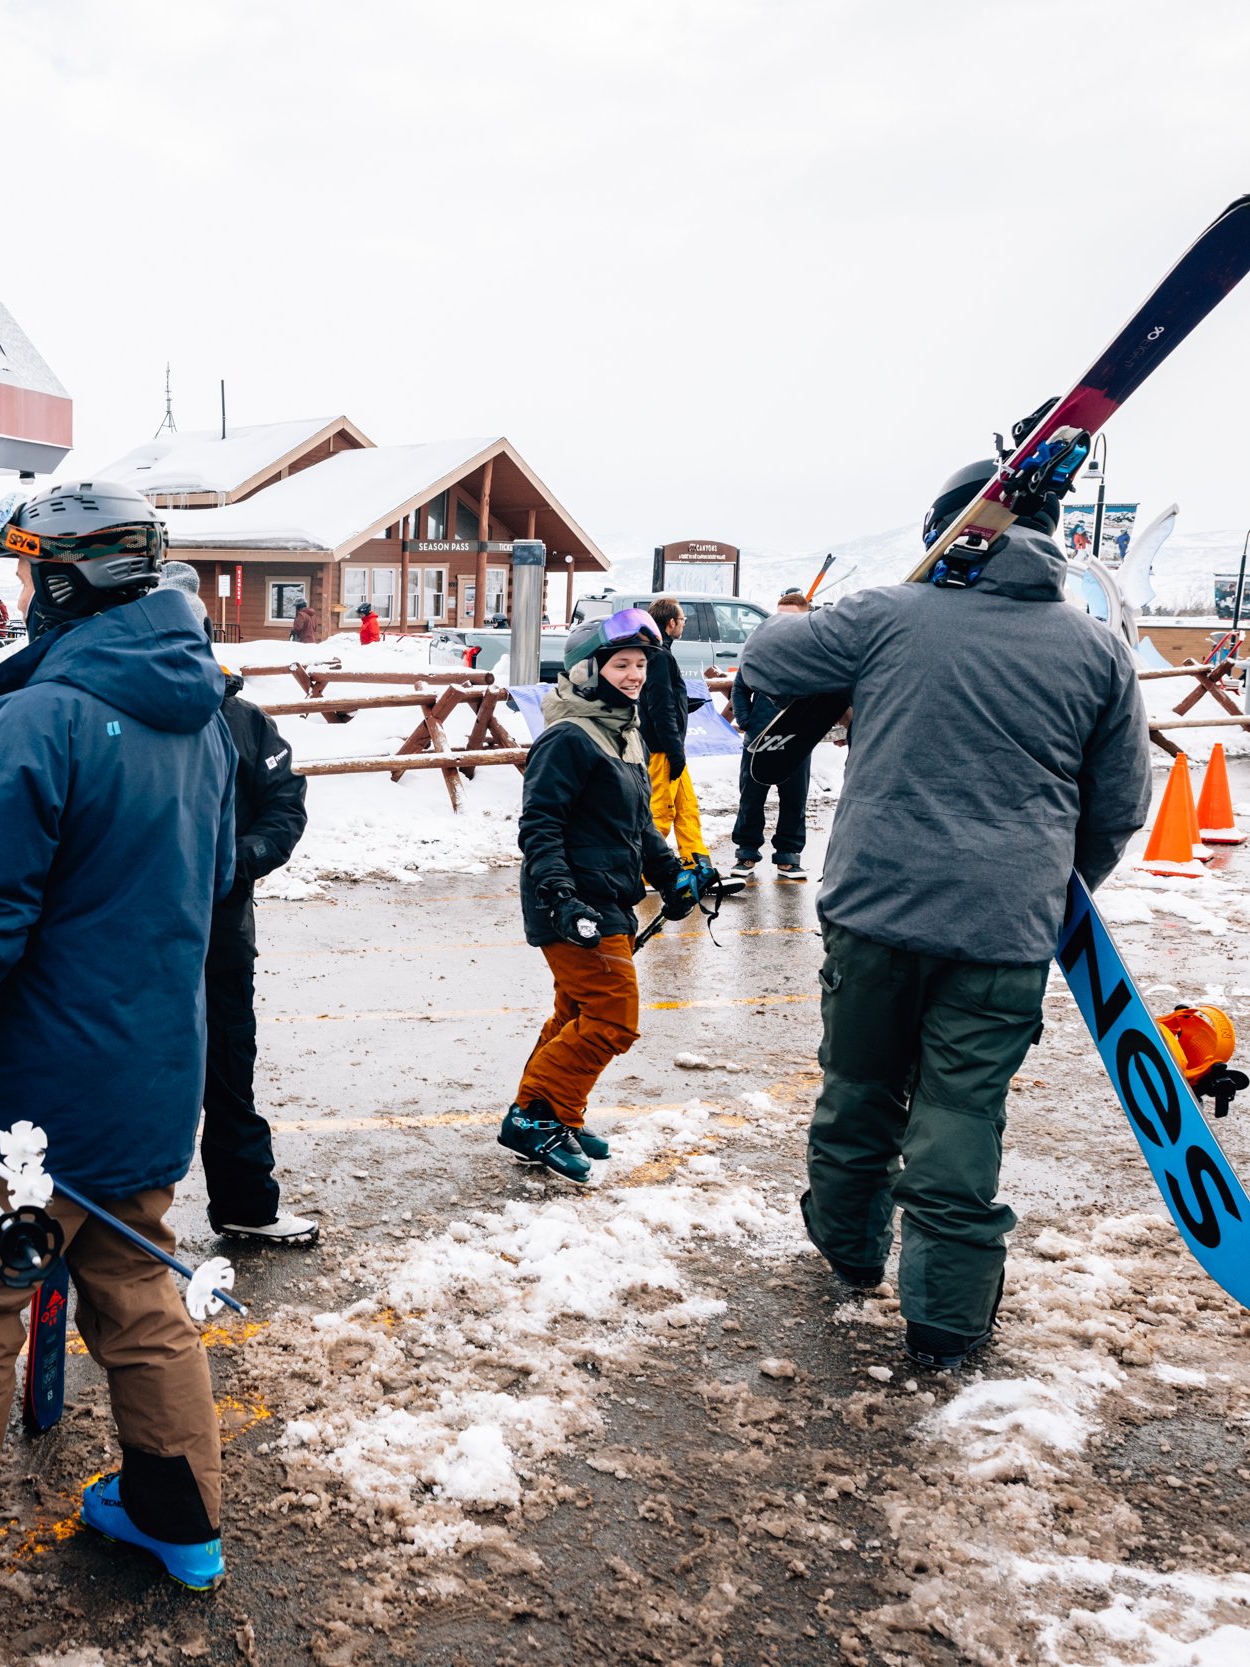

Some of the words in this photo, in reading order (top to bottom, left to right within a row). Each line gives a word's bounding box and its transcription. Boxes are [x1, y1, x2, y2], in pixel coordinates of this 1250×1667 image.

[8, 533, 27, 548] SPY
[419, 543, 450, 551] SEASON
[452, 543, 469, 551] PASS
[499, 543, 513, 551] TICKE
